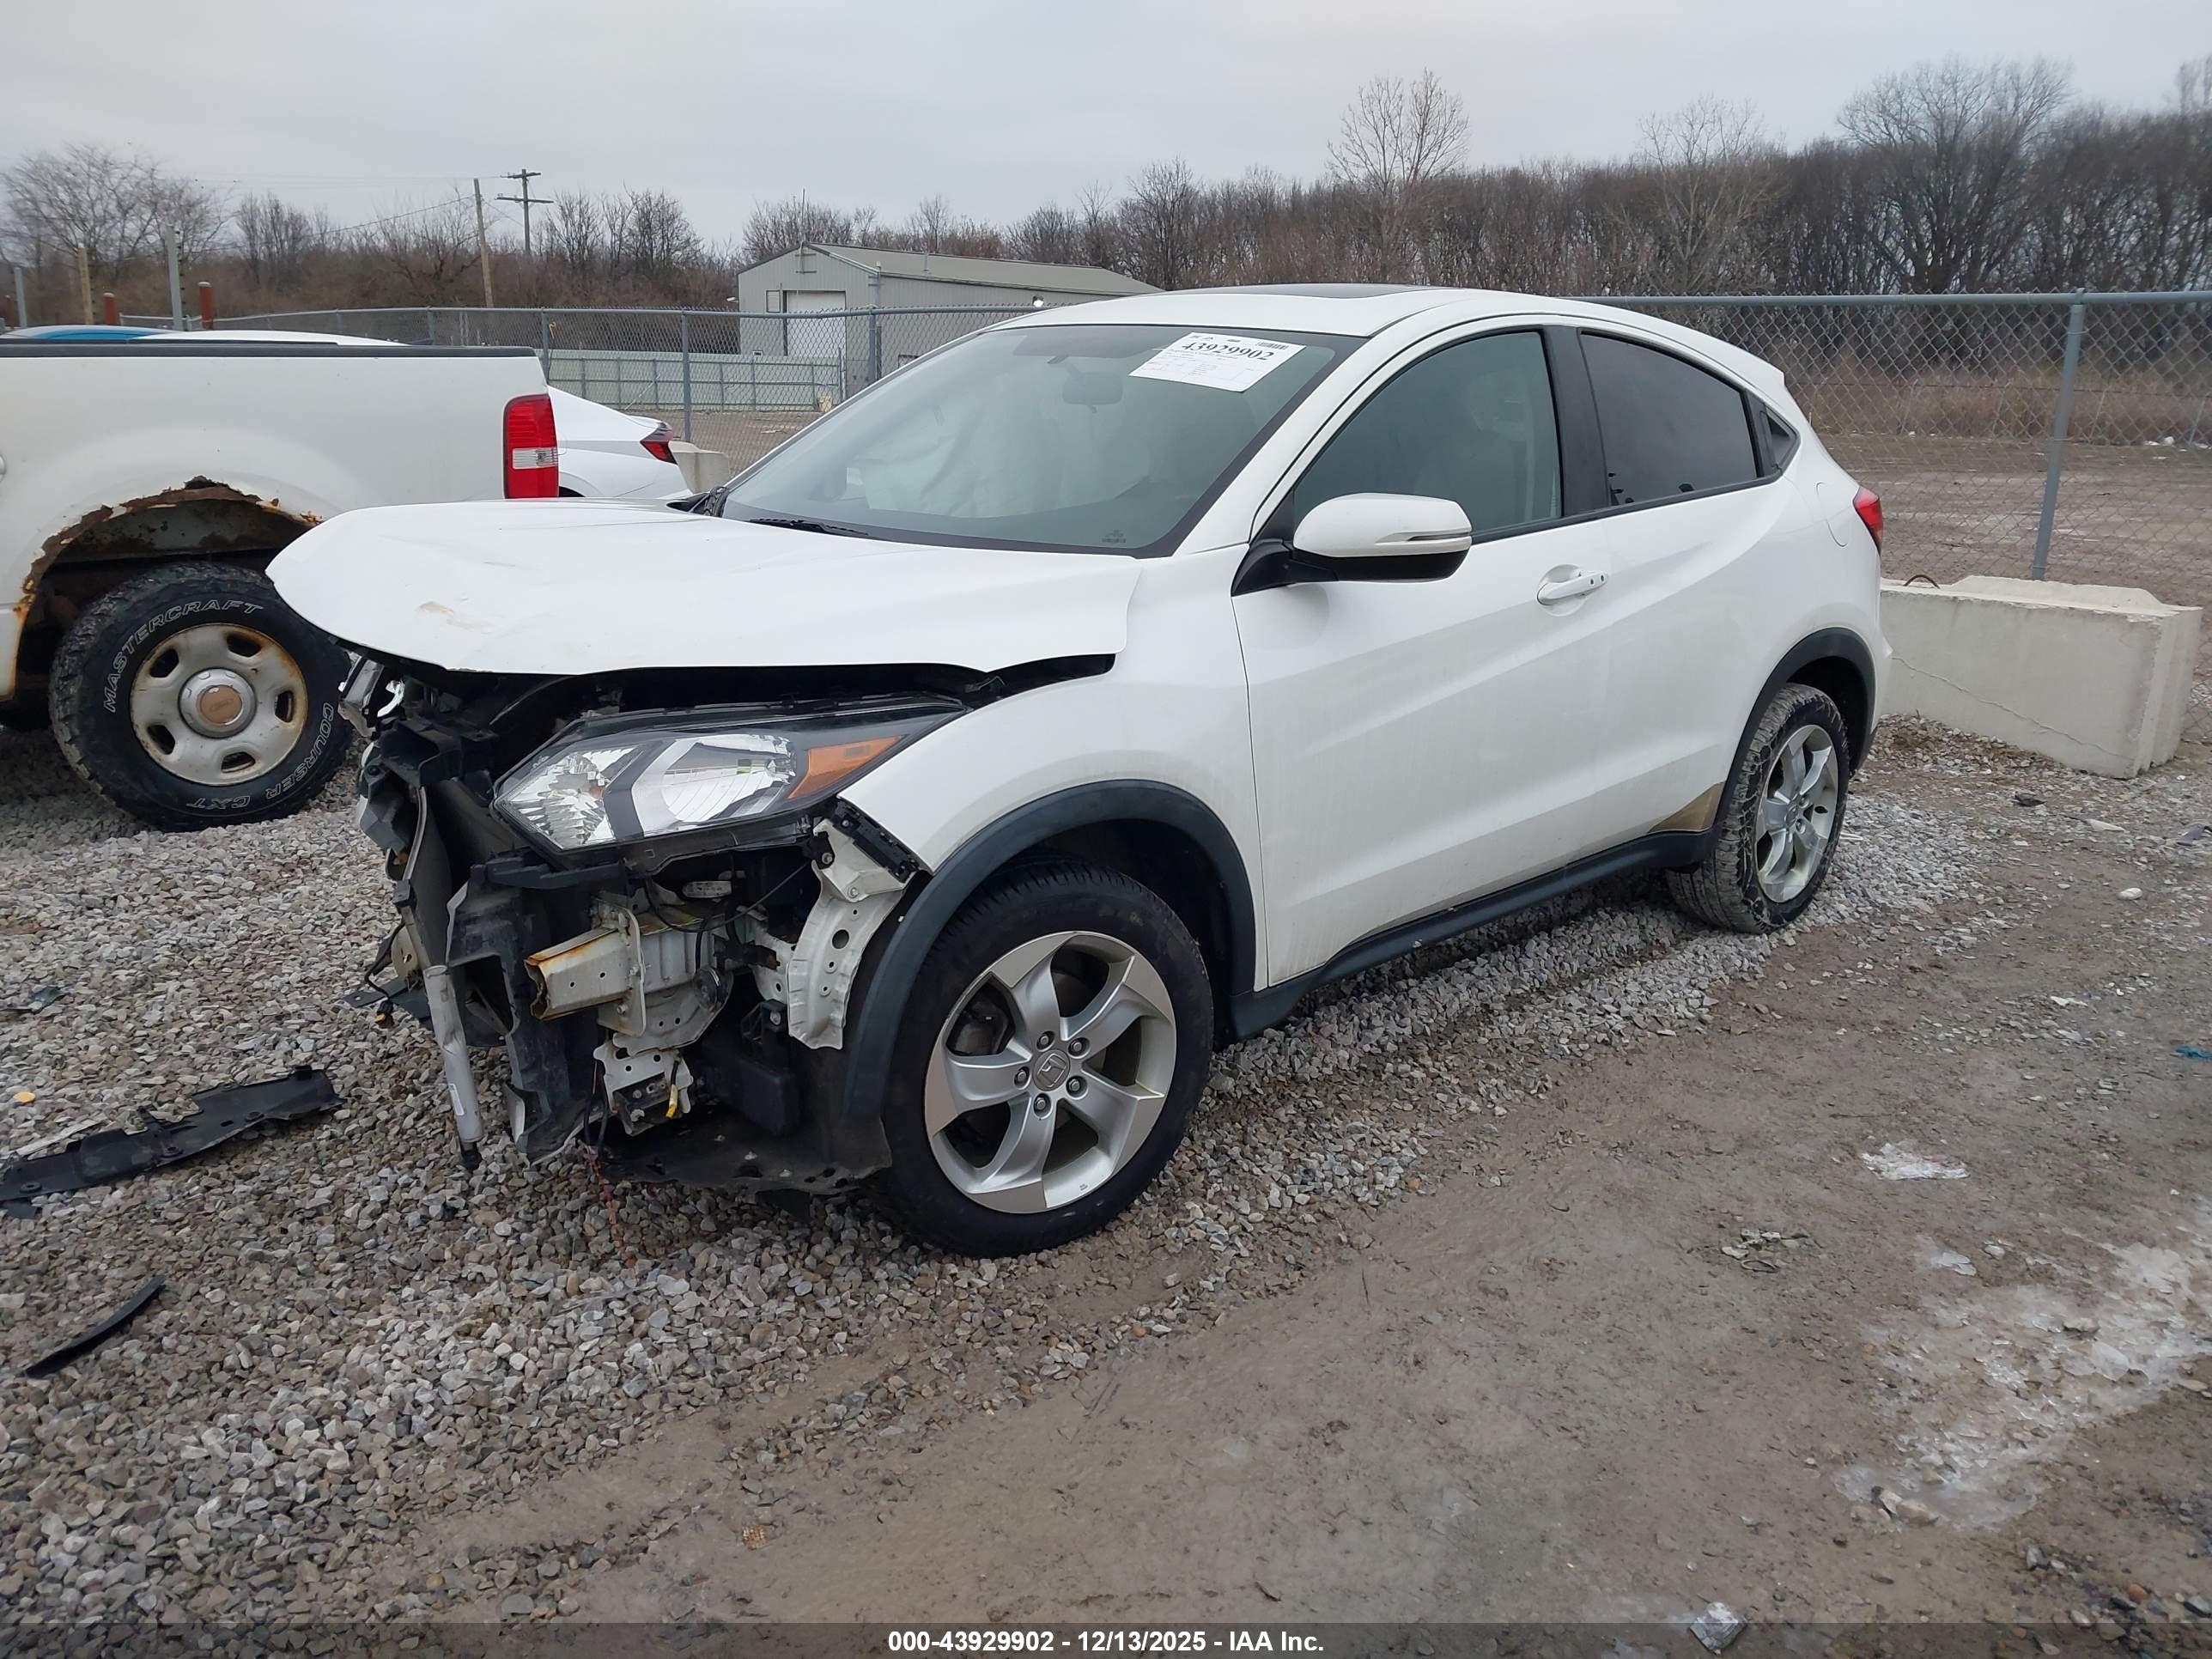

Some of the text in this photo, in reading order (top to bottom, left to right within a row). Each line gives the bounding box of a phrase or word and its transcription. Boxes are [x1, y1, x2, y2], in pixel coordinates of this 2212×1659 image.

[1182, 342, 1274, 361] 43929902
[103, 599, 264, 714] MASTERCRAFT
[185, 702, 334, 811] COURSER CXT
